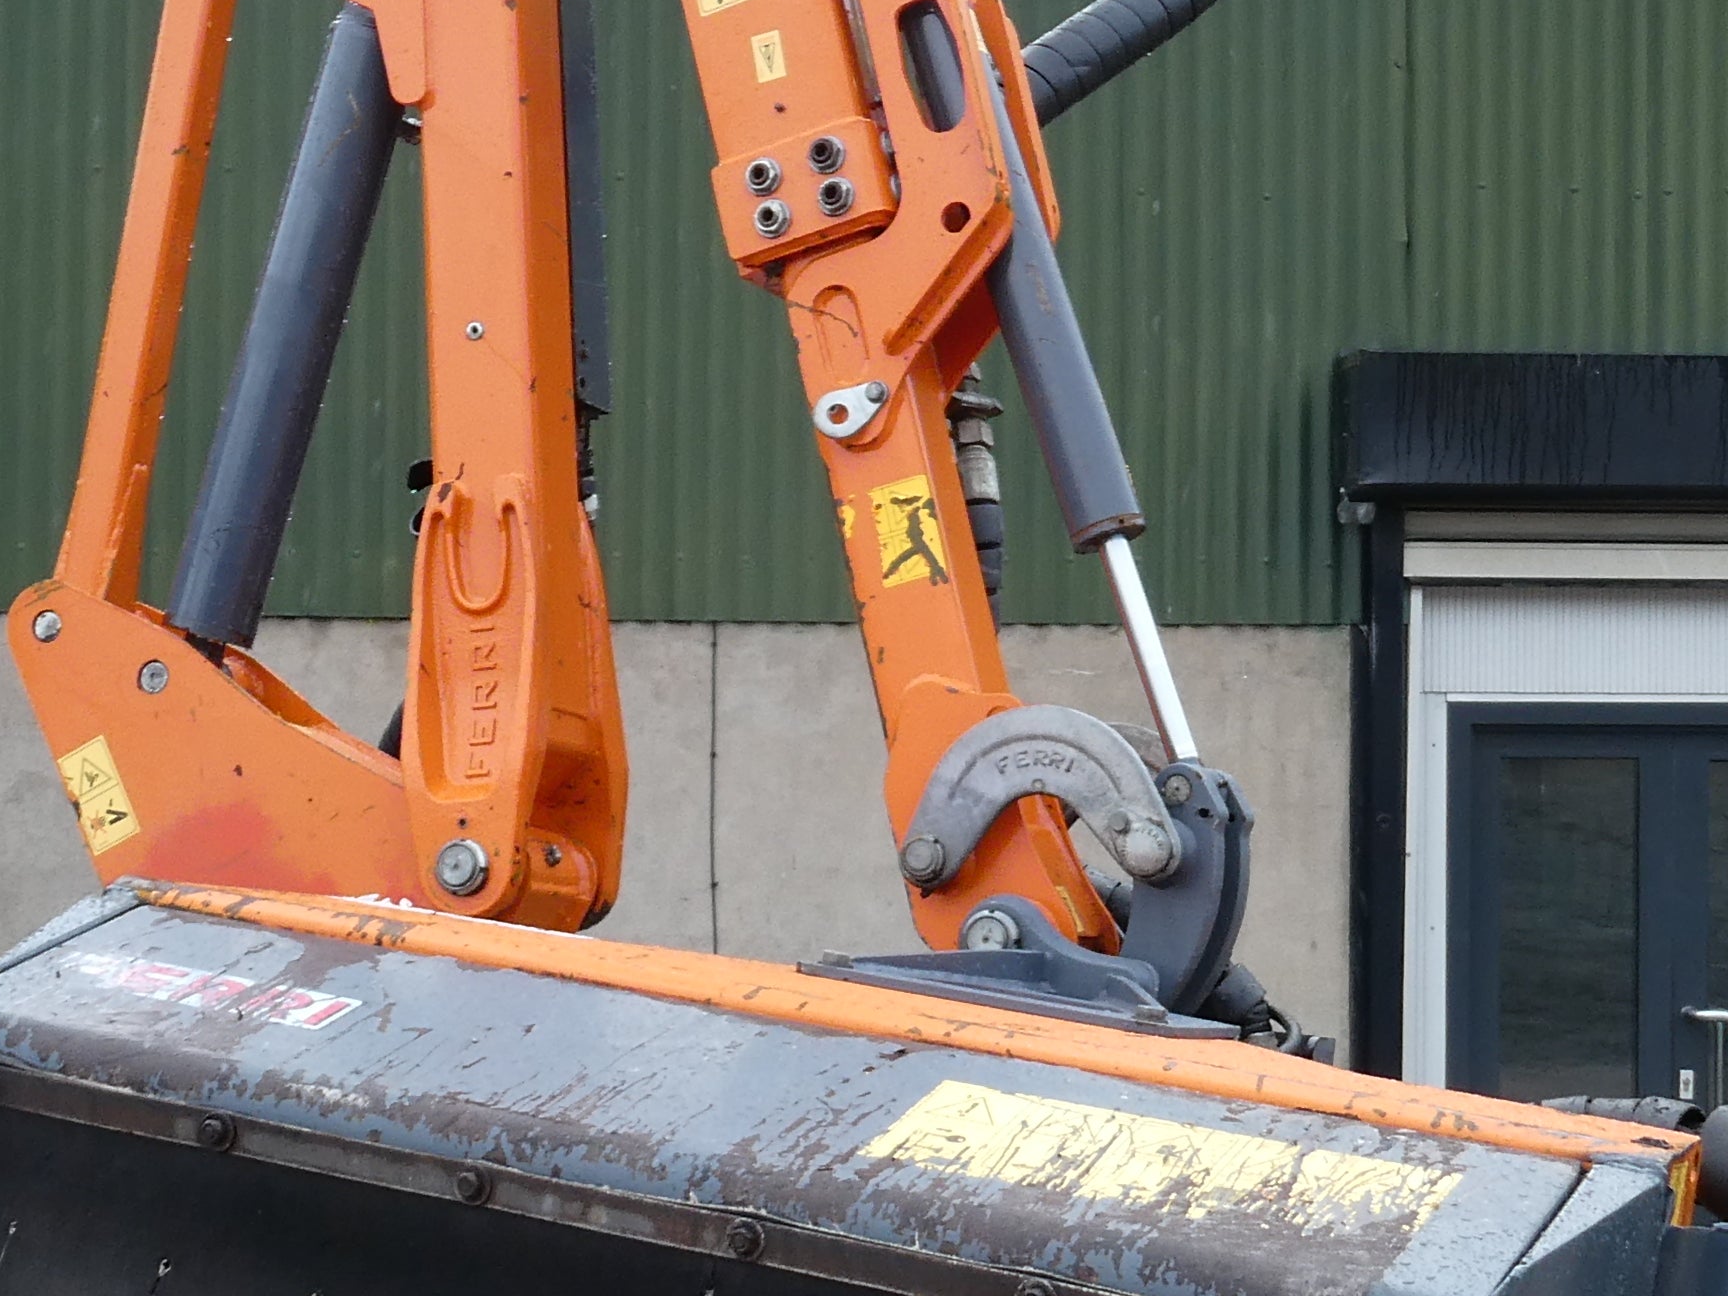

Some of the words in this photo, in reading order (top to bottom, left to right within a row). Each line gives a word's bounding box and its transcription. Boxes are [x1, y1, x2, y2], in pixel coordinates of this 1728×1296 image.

[465, 626, 498, 779] FERRI
[995, 750, 1074, 774] FERRI
[94, 962, 352, 1026] ERRI
